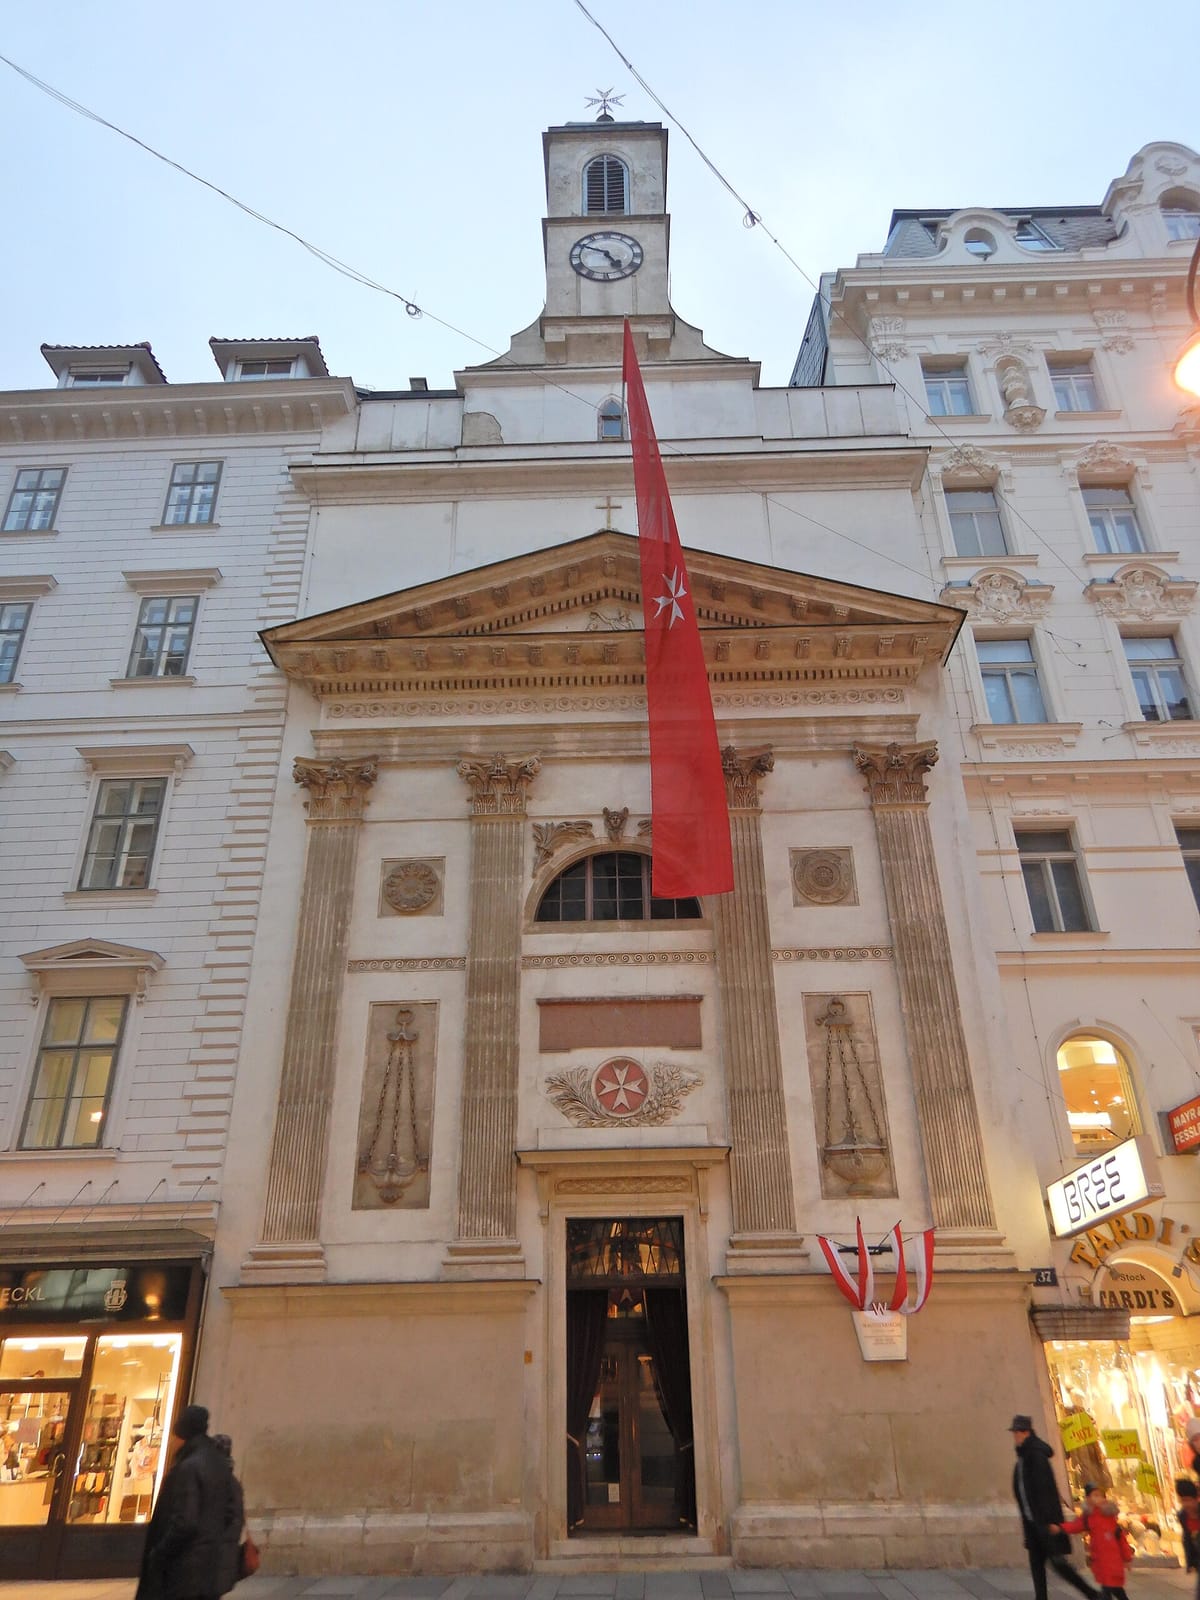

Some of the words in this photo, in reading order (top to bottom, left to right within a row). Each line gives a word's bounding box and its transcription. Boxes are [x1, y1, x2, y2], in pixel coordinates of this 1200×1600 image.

[1173, 1108, 1196, 1128] MAYR
[1063, 1155, 1126, 1224] BREE
[1037, 1271, 1051, 1282] 37
[1119, 1273, 1146, 1281] Stock
